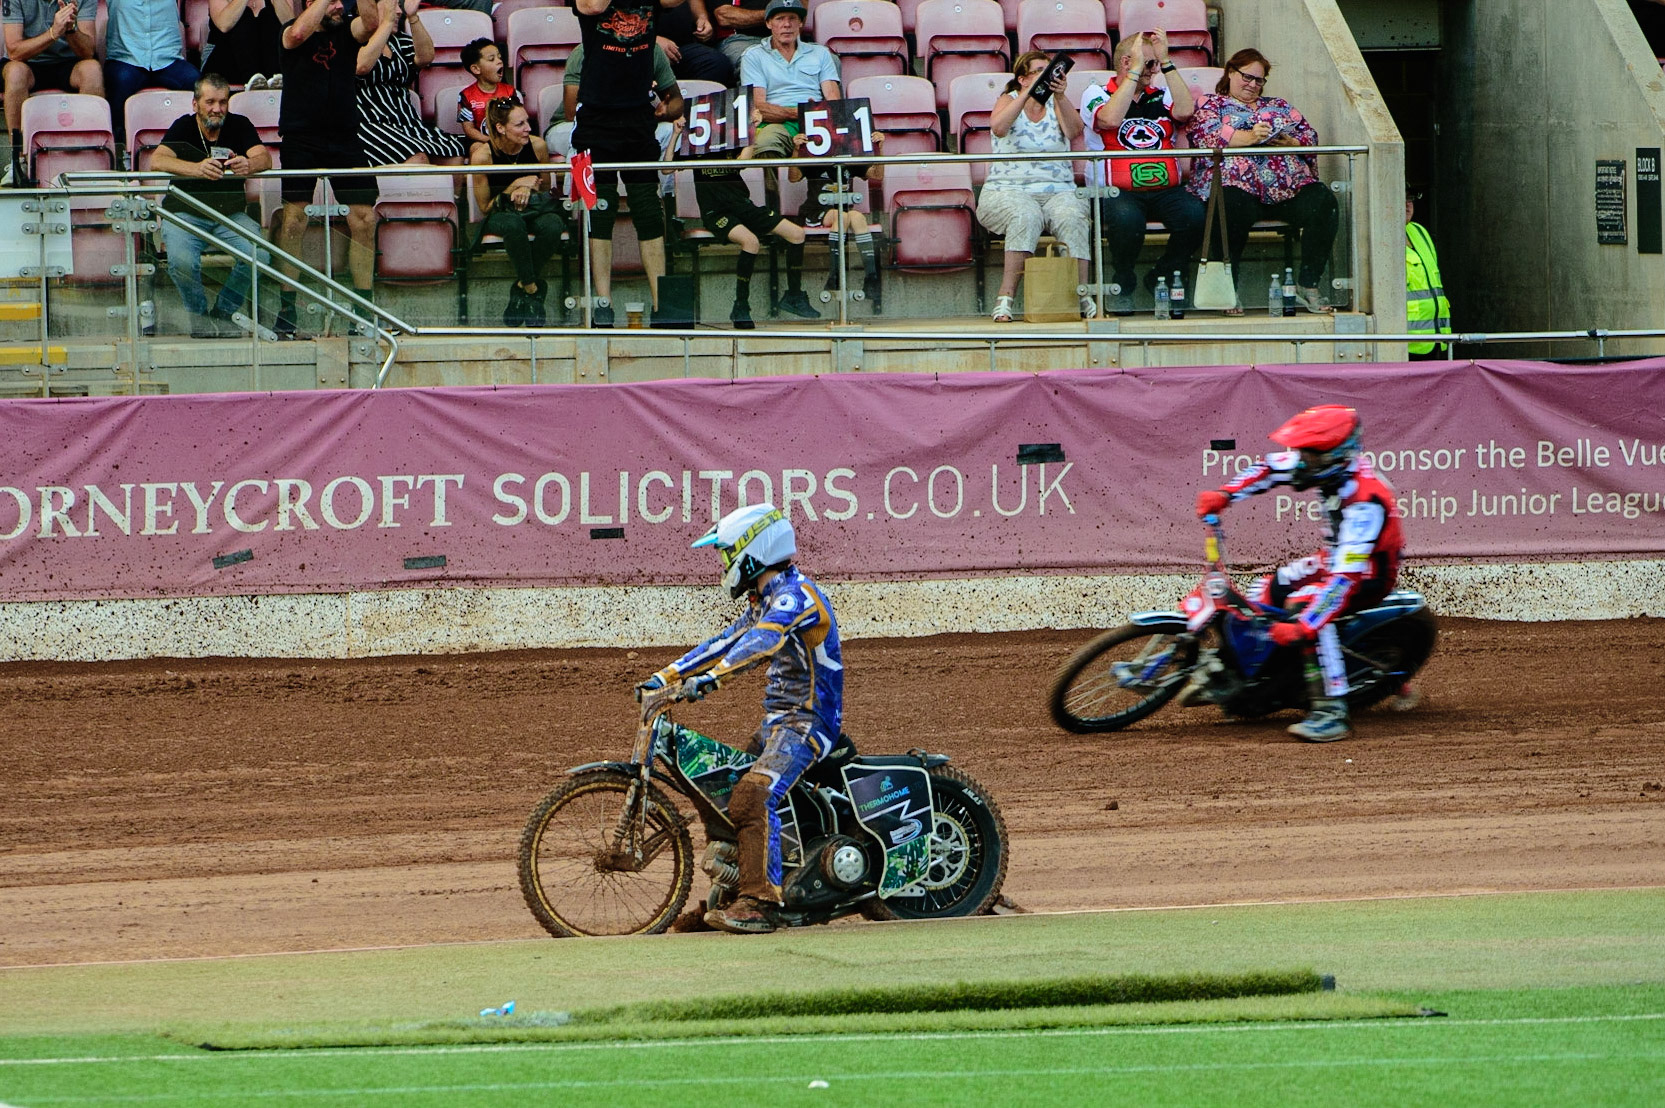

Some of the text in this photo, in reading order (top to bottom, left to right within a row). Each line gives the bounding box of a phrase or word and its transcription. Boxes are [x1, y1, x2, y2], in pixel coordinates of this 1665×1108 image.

[602, 44, 626, 53] LIMITED
[1637, 157, 1656, 172] BLOCK B
[1475, 439, 1526, 469] the
[1537, 438, 1610, 468] Belle
[1466, 486, 1561, 517] Junior
[1572, 486, 1665, 519] Leagu
[859, 785, 911, 812] THERMOHOME
